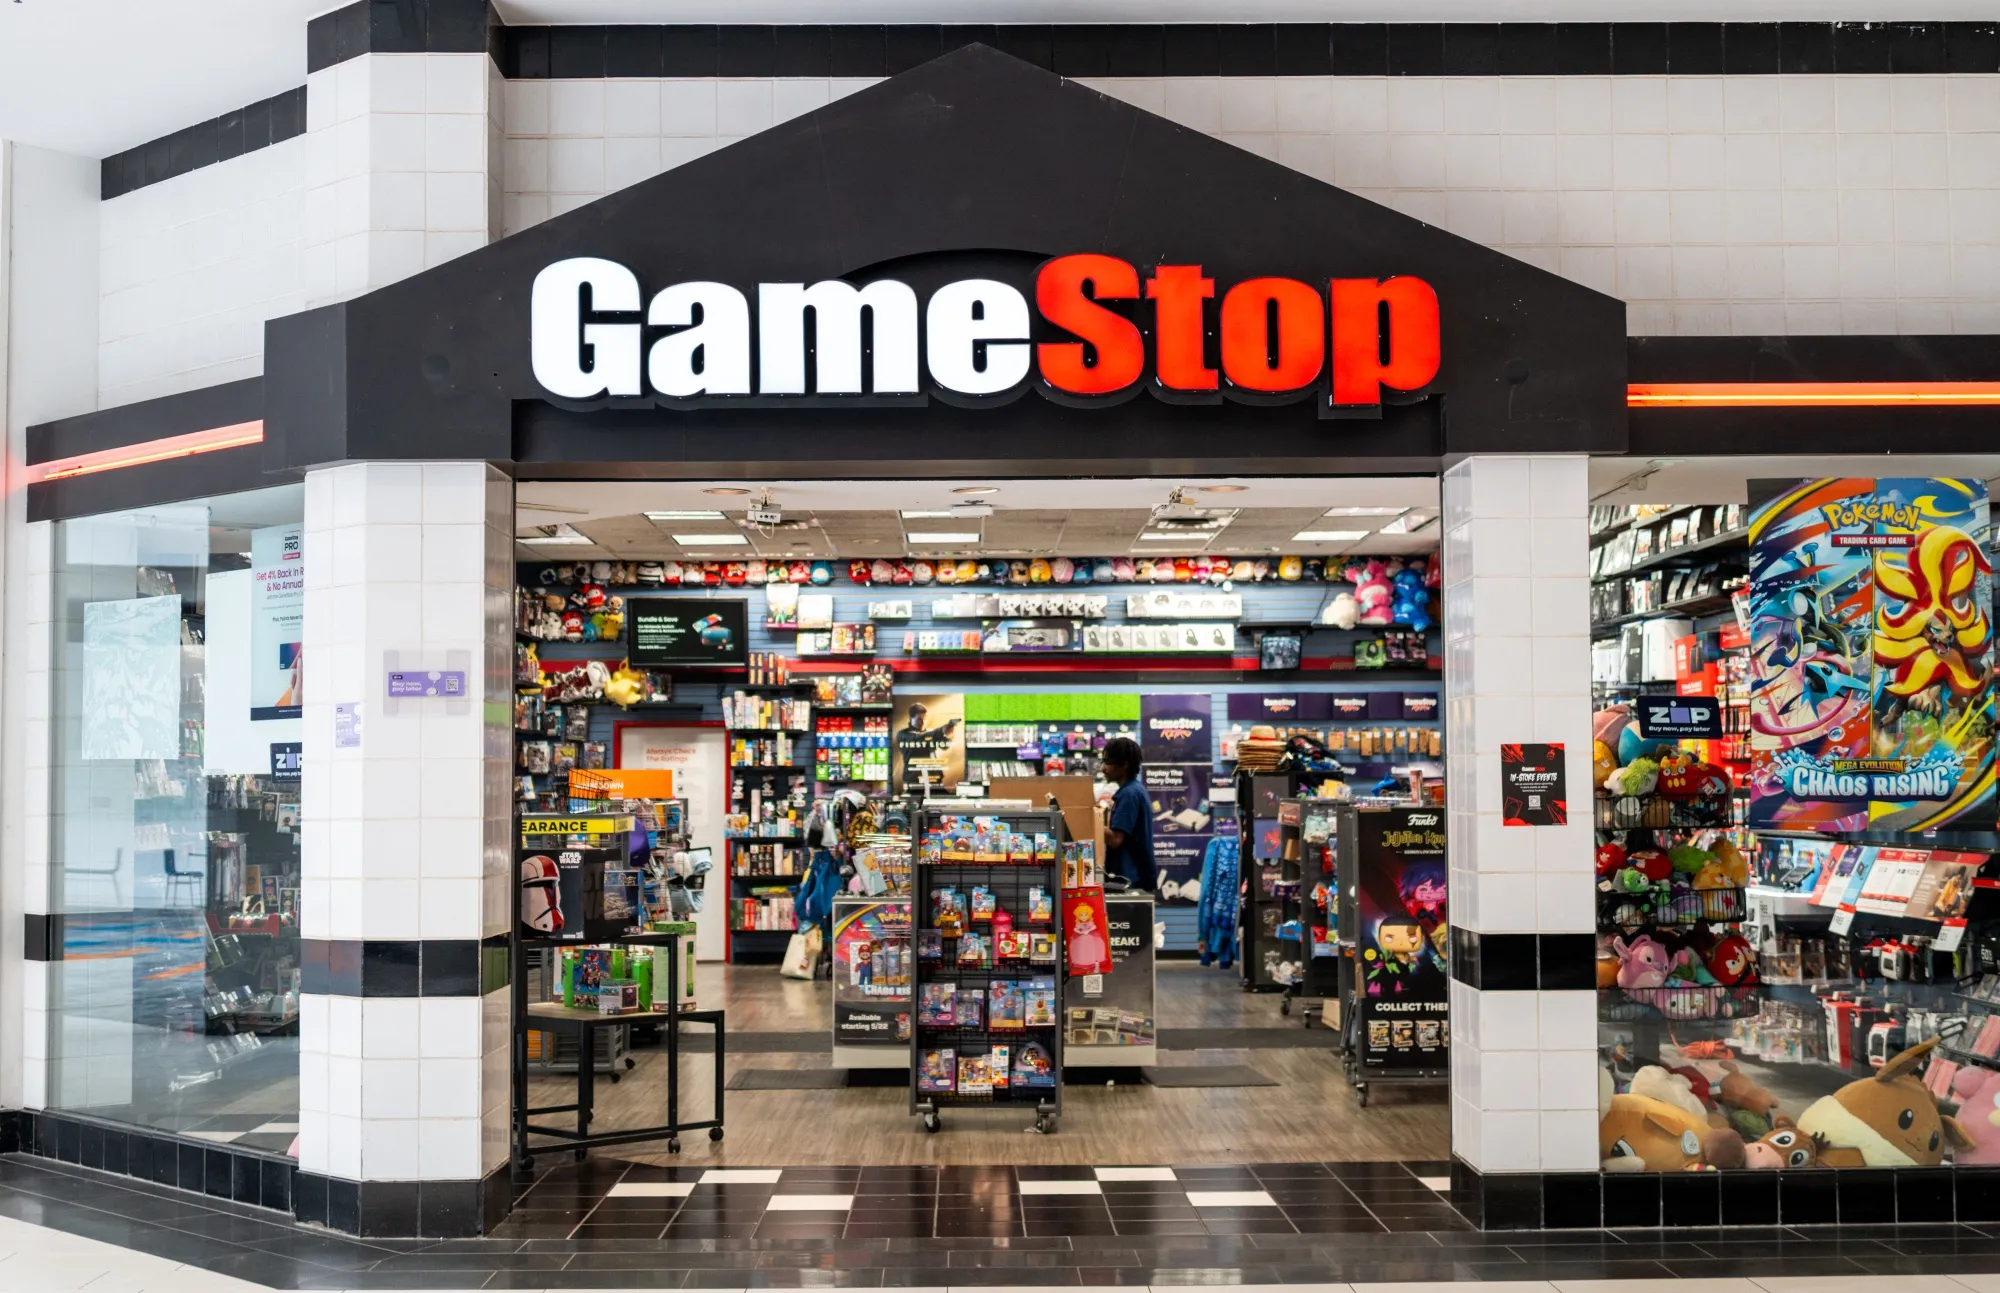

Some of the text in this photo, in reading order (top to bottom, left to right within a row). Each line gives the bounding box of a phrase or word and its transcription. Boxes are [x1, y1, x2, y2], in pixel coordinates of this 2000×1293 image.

[532, 254, 1441, 406] GameStop
[1840, 536, 1907, 544] TRADING CARD GAME
[284, 541, 298, 551] PRO
[256, 572, 267, 581] Get
[268, 570, 276, 580] 4%
[277, 568, 292, 579] Back
[293, 567, 299, 577] in
[267, 579, 304, 592] & No Annual
[1150, 718, 1202, 731] GameStop
[1834, 760, 1904, 772] MEGA EVOLUTION
[1510, 772, 1557, 782] IN-STORE EVENTS
[1793, 766, 1949, 796] CHAOS RISING
[1408, 814, 1438, 826] Funko
[1176, 848, 1199, 856] History
[865, 985, 894, 995] CHAOS
[1375, 1003, 1422, 1011] COLLECT
[842, 1023, 870, 1031] starting
